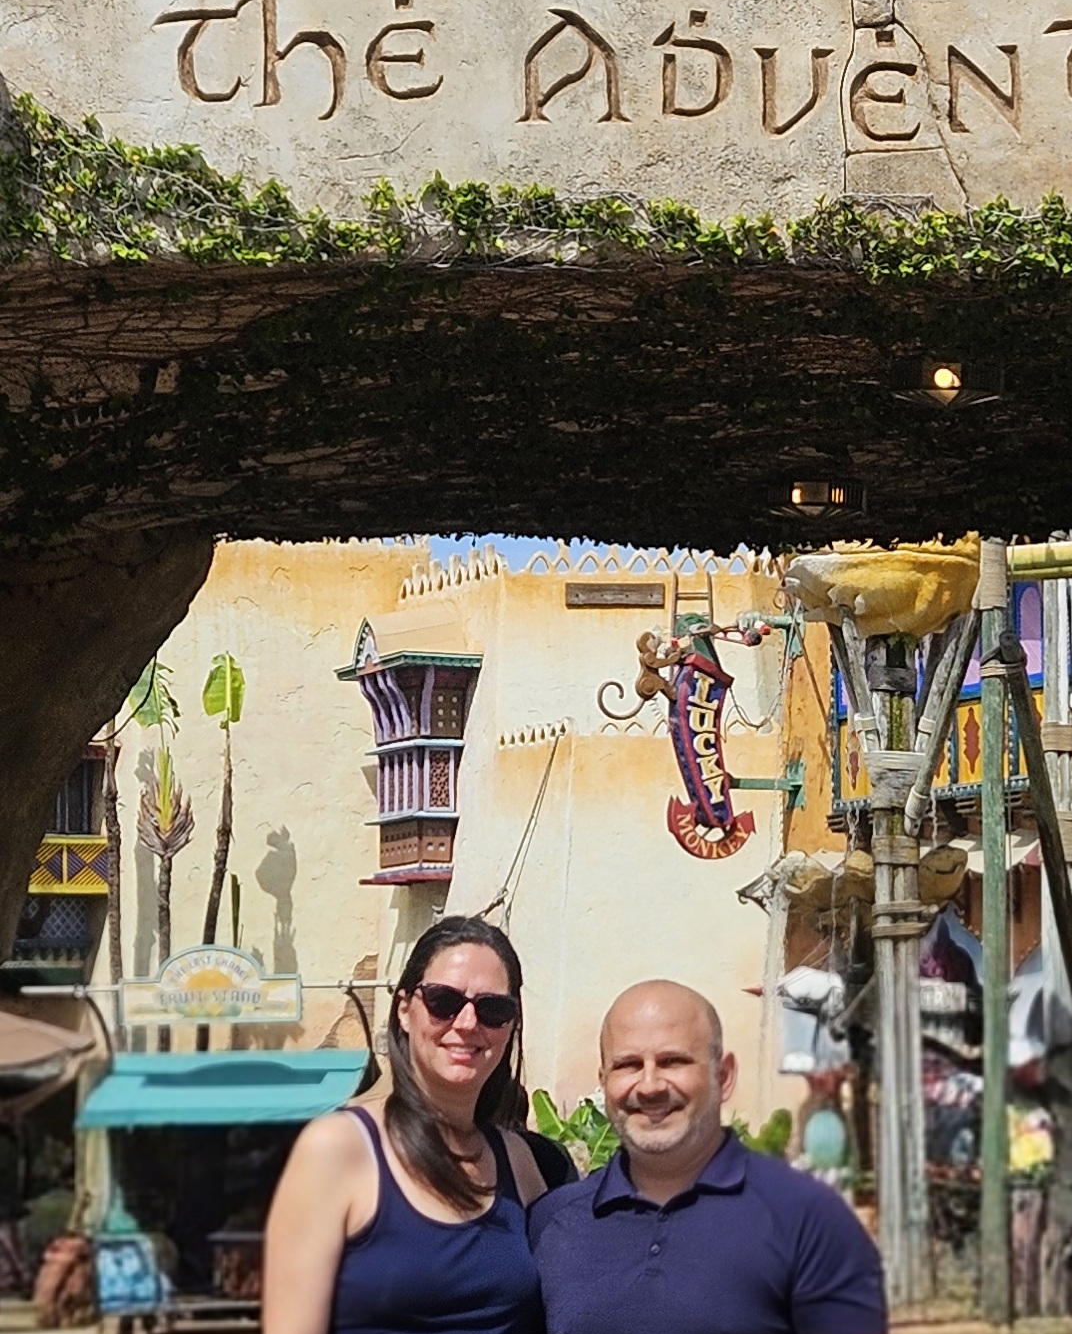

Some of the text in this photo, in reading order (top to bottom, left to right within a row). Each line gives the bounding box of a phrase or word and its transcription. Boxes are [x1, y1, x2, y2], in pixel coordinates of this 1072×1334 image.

[687, 670, 725, 805] LUCKY
[677, 813, 749, 859] MONKEY
[189, 955, 212, 969] LAST
[160, 988, 262, 1007] FRUIT STAND
